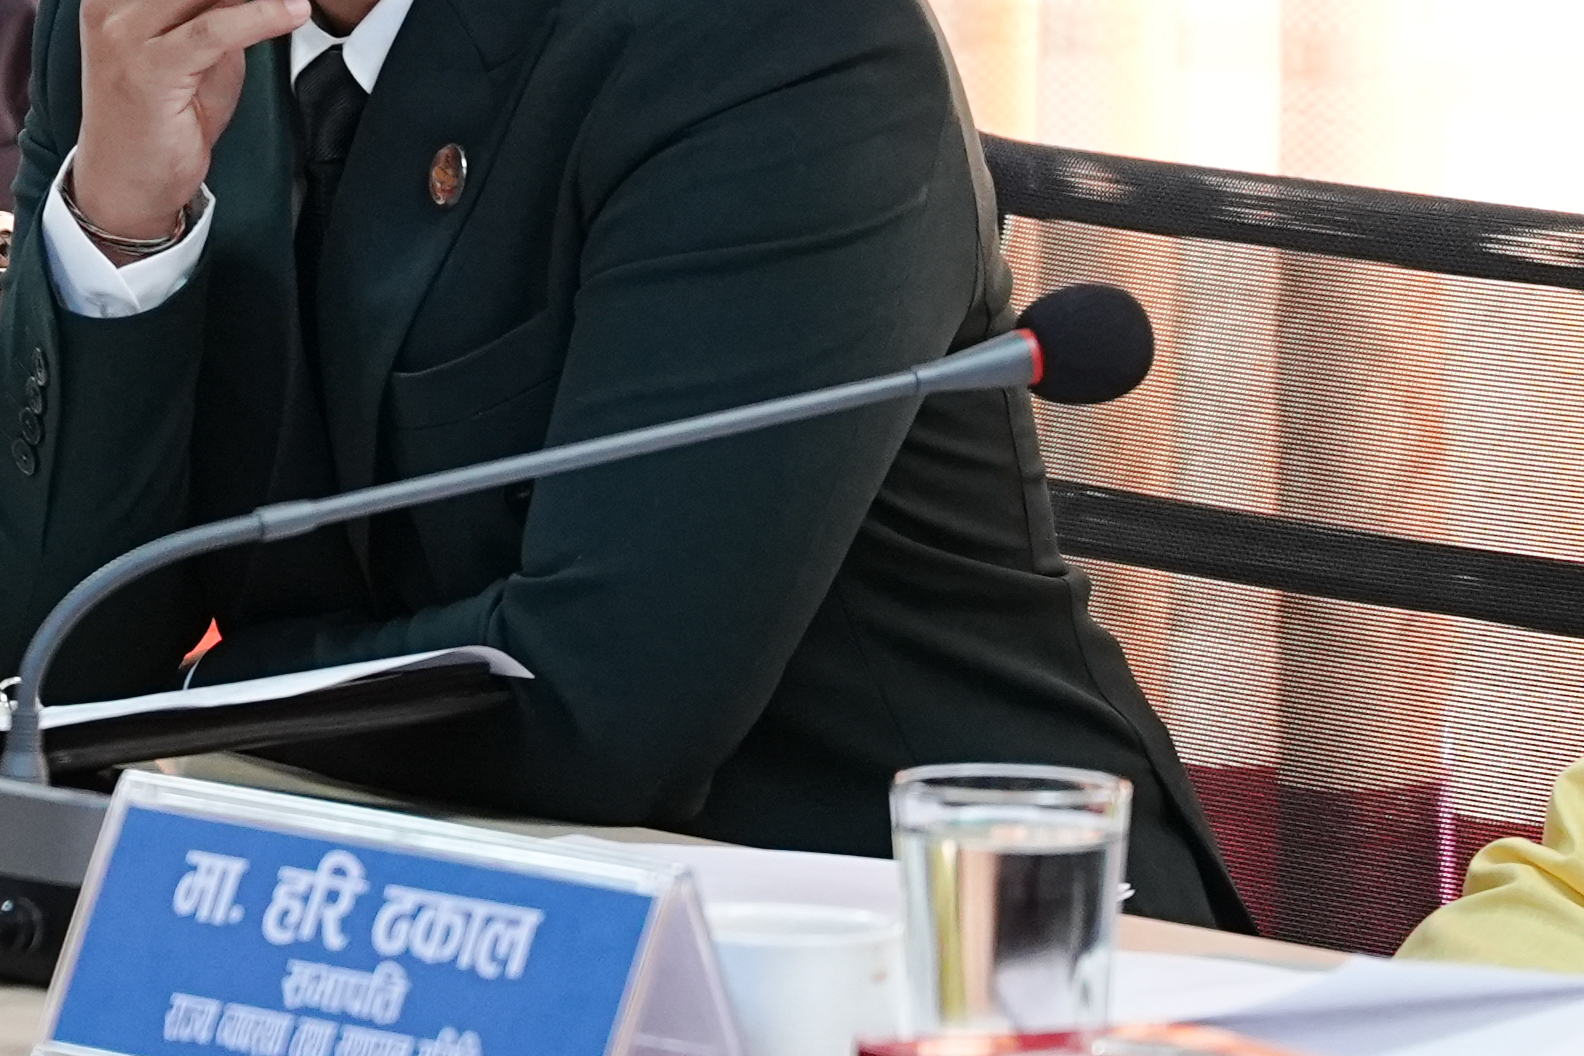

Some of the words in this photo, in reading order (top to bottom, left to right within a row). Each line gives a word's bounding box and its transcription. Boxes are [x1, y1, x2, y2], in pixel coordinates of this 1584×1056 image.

[173, 850, 249, 927] मा.
[262, 849, 368, 952] हरि
[370, 883, 545, 980] ढकाल
